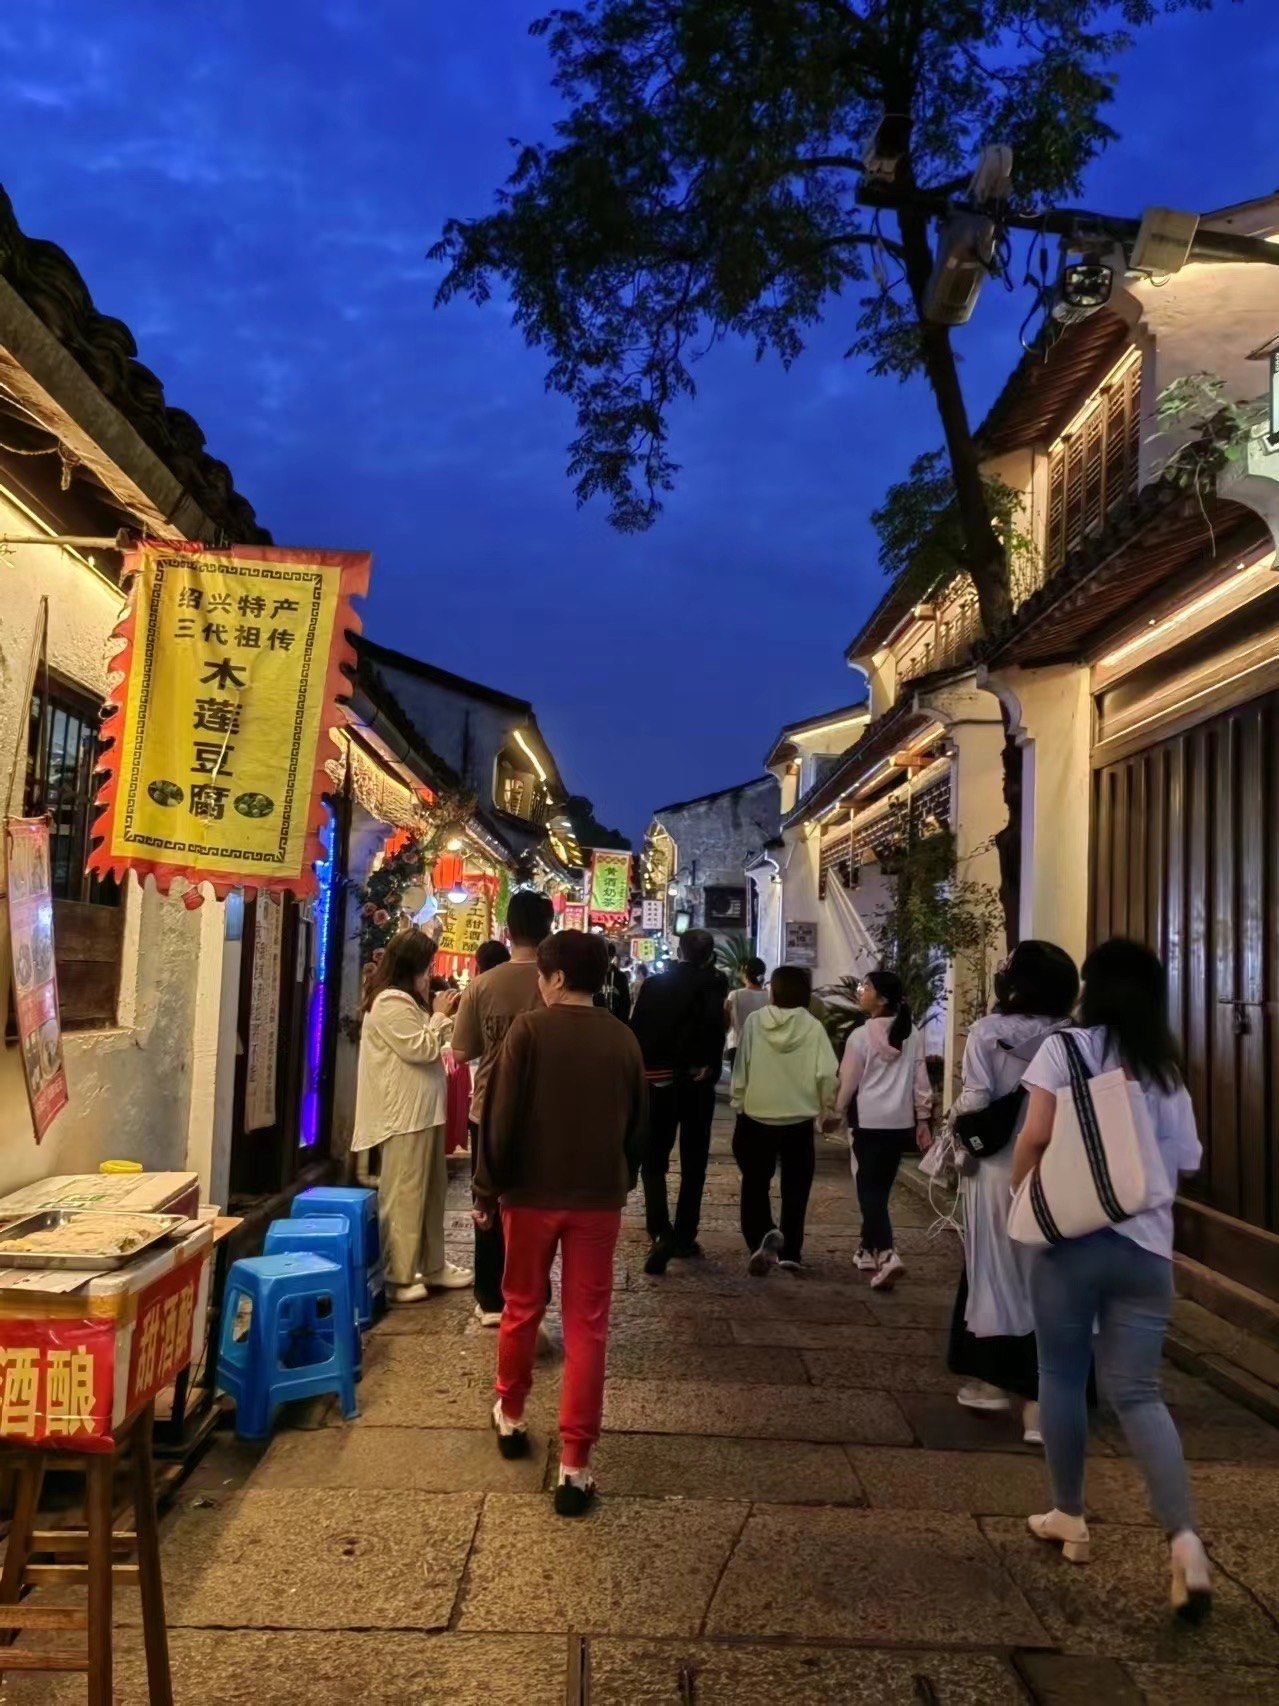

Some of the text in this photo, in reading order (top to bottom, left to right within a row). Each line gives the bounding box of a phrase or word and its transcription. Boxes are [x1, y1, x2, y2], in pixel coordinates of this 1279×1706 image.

[178, 586, 299, 619] 绍兴特产
[174, 618, 296, 652] 三代祖传
[188, 657, 248, 820] 木莲豆腐
[602, 867, 618, 907] 黄酒奶茶
[0, 1345, 96, 1437] 酒酿
